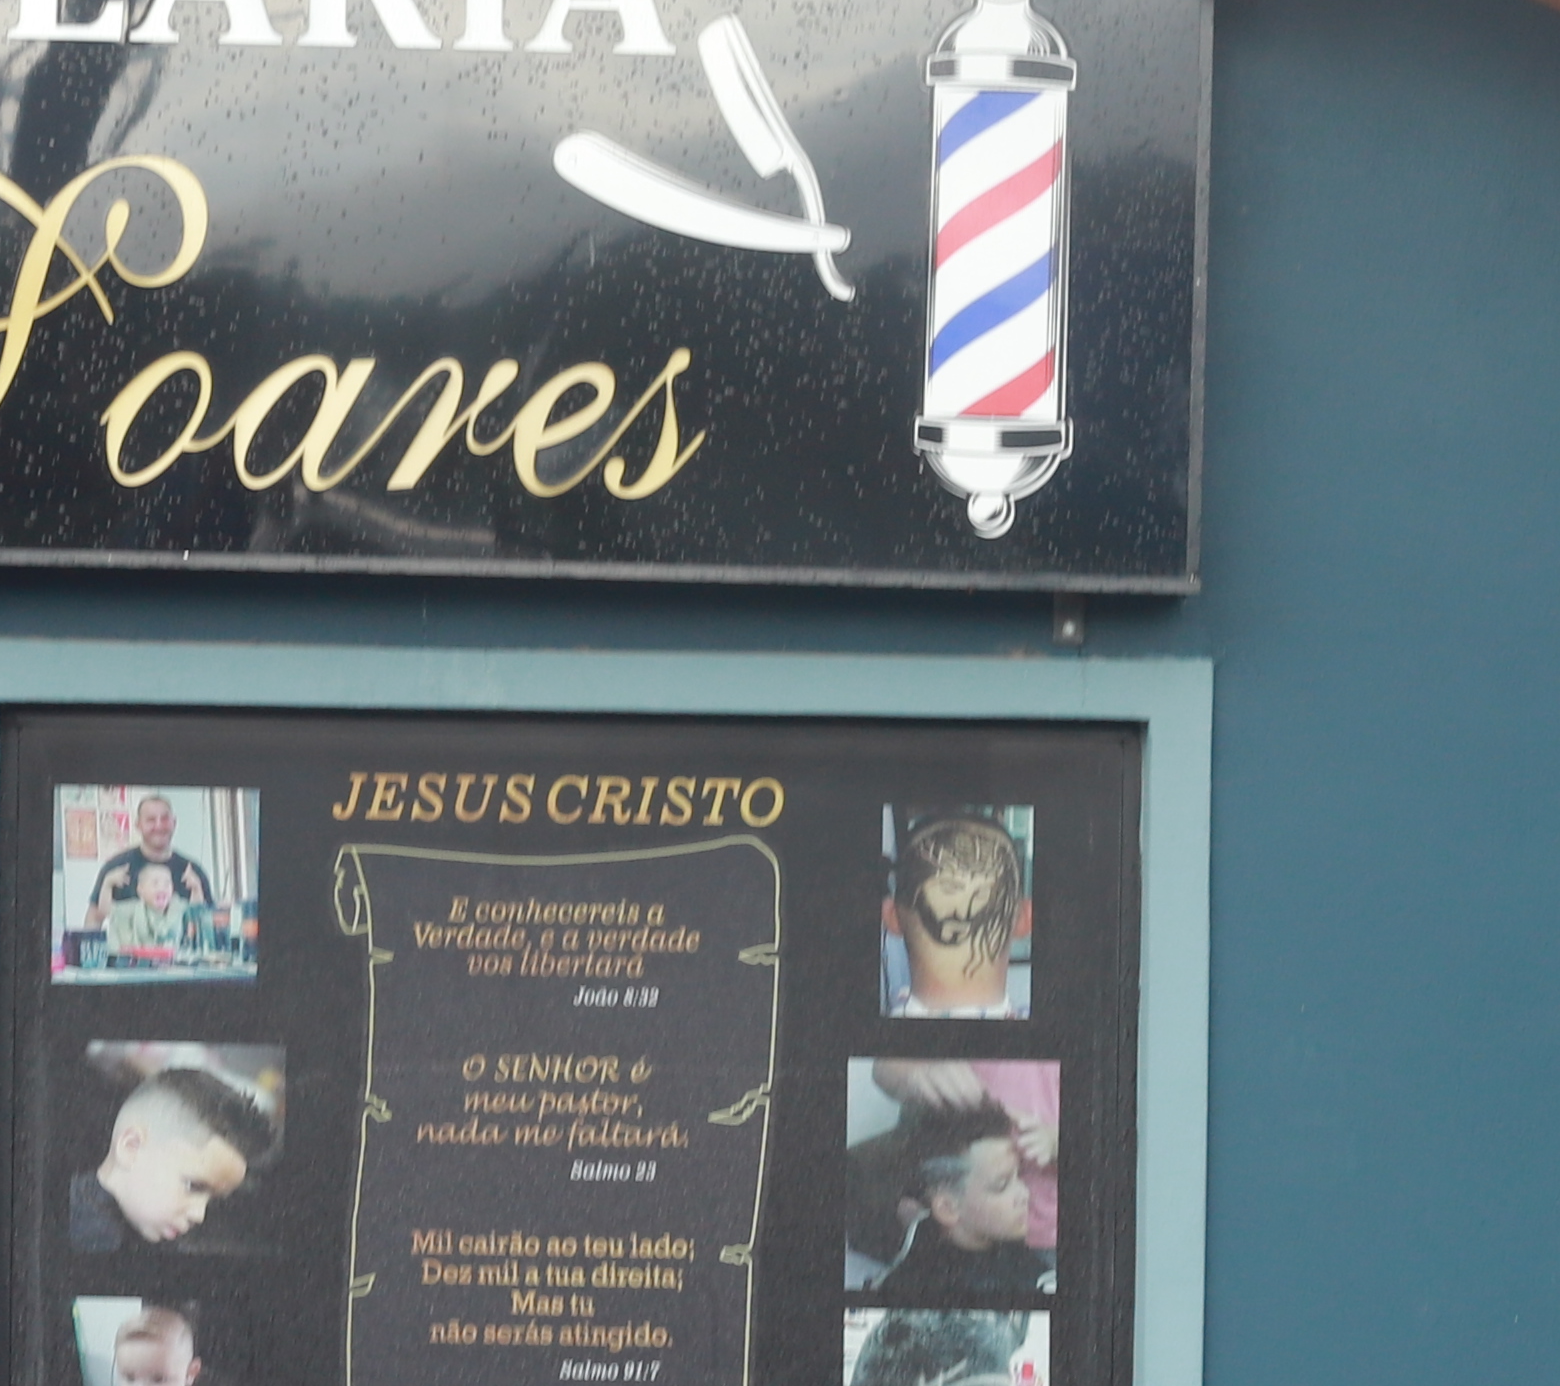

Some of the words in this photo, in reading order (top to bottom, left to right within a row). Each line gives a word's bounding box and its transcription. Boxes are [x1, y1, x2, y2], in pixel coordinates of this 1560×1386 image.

[331, 771, 535, 823] JESUS
[546, 774, 785, 827] CRISTO
[448, 895, 469, 924] E
[475, 898, 641, 926] conhecereis
[647, 902, 665, 926] a
[413, 921, 532, 951] Verdade,
[540, 927, 555, 951] e
[562, 927, 580, 951] a
[586, 923, 700, 953] verdade
[467, 952, 512, 977] vos
[462, 1053, 486, 1082] O
[494, 1052, 621, 1085] SENHOR
[463, 1088, 534, 1114] meu
[537, 1087, 643, 1123] pastor,
[416, 1114, 509, 1146] nada
[514, 1121, 564, 1147] me
[570, 1159, 631, 1183] Salmo
[634, 1160, 657, 1183] 23
[410, 1227, 453, 1256] Mil
[458, 1230, 540, 1257] cairão
[546, 1235, 577, 1258] ao
[583, 1233, 625, 1259] teu
[629, 1231, 695, 1263] lado;
[421, 1257, 472, 1286] Dez
[477, 1259, 520, 1286] mil
[525, 1264, 540, 1287] a
[546, 1261, 586, 1288] tua
[591, 1261, 684, 1293] direita;
[510, 1287, 564, 1317] Mas
[570, 1291, 596, 1318] tu
[429, 1317, 478, 1346] não
[483, 1318, 553, 1346] serás
[558, 1319, 673, 1354] atingido.
[559, 1358, 620, 1382] Salmo
[623, 1359, 661, 1383] 91/7
